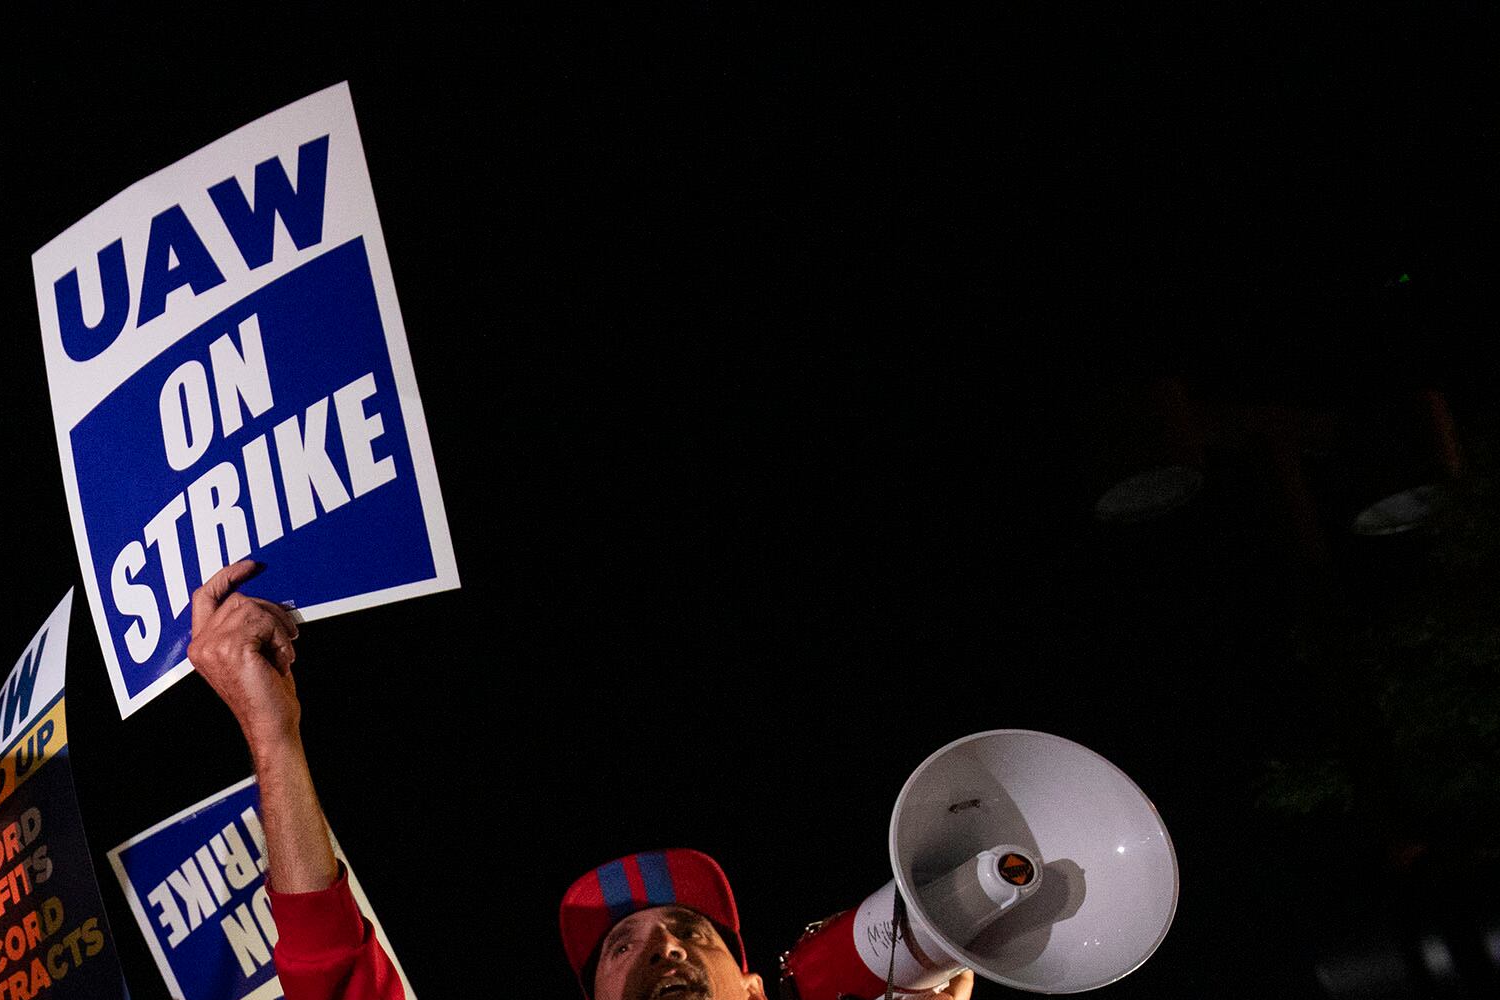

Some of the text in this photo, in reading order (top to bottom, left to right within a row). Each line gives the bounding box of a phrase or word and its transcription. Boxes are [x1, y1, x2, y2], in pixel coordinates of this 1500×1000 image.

[54, 134, 329, 362] UAW
[159, 314, 274, 472] ON
[110, 372, 397, 665] STRIKE
[16, 719, 54, 776] UP
[146, 805, 269, 950] TRIKE
